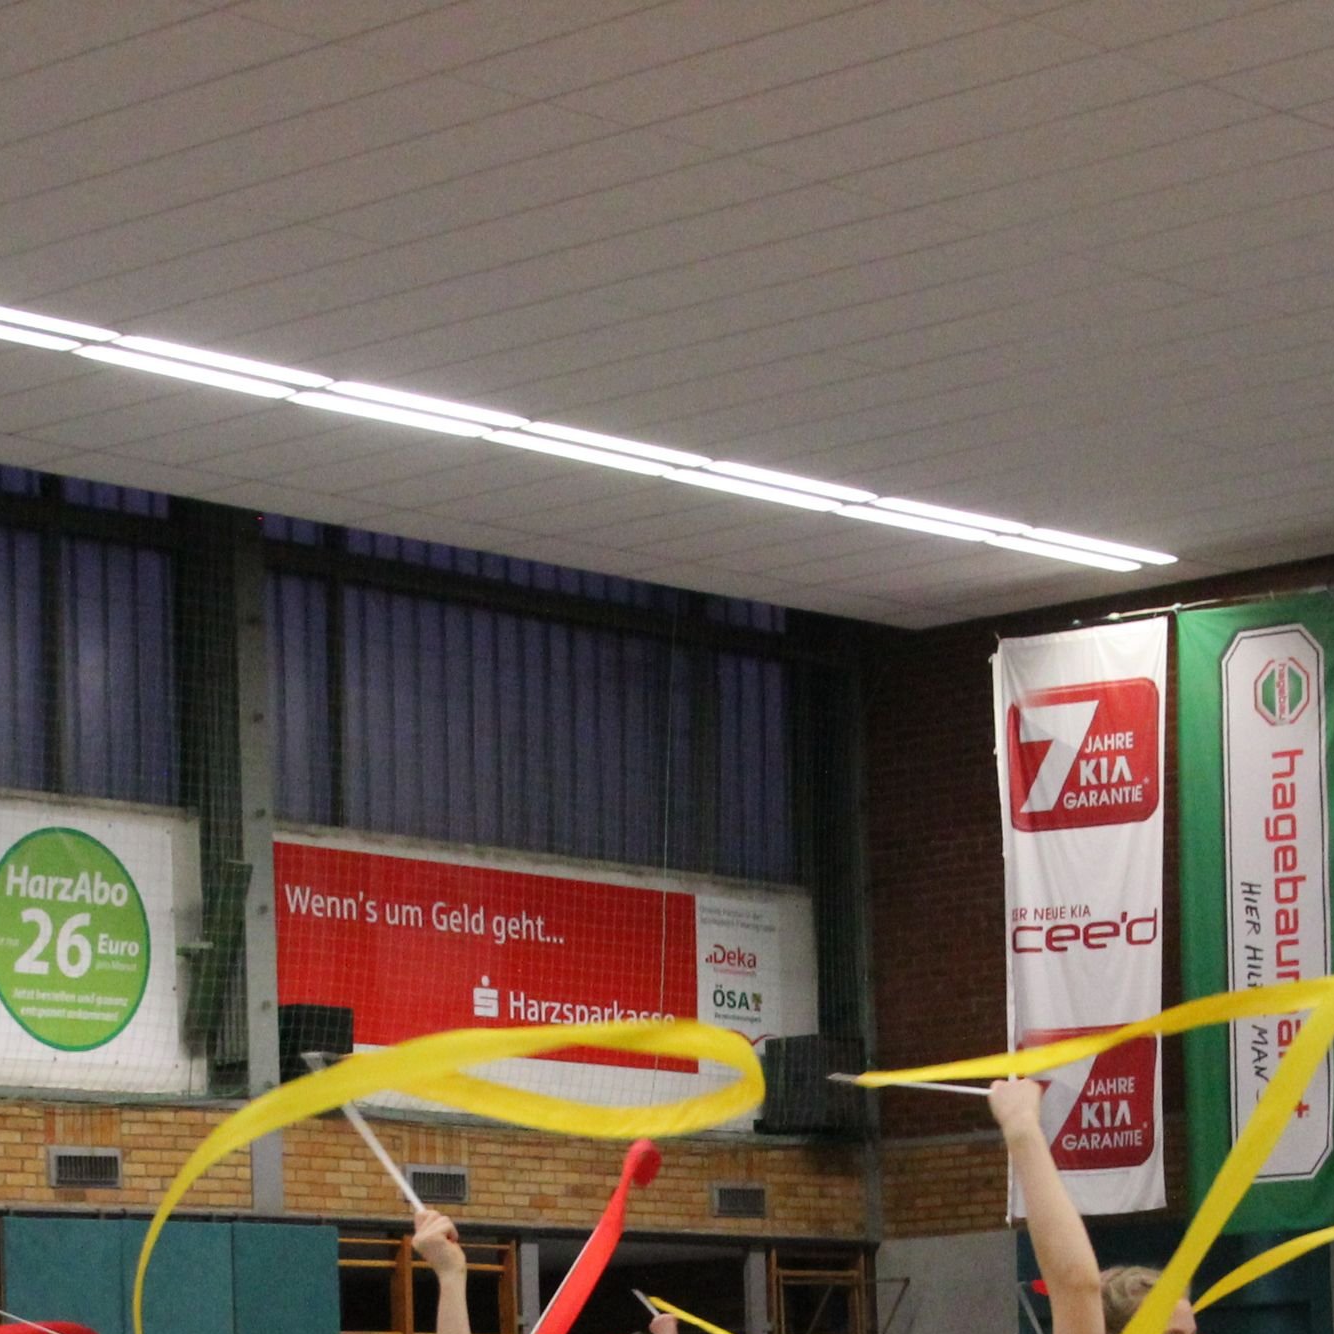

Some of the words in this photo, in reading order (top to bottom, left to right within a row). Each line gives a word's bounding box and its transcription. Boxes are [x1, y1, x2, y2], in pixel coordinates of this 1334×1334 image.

[1019, 700, 1100, 813] 7
[1085, 732, 1134, 754] JAHRE
[1079, 755, 1133, 786] KIA
[1063, 784, 1144, 810] GARANTIE
[5, 863, 128, 908] HarzAbo
[385, 902, 423, 929] um
[431, 901, 485, 934] Geld
[1034, 906, 1067, 921] NEUE
[1070, 904, 1092, 919] KIA
[14, 907, 93, 979] 26
[98, 932, 140, 957] Euro
[1012, 907, 1158, 953] cee'd
[1265, 747, 1309, 1119] hagebauat
[713, 943, 757, 968] Deka
[1240, 881, 1262, 936] HIER
[1251, 1024, 1270, 1082] MAN
[713, 984, 750, 1010] ÖSA
[1087, 1076, 1135, 1097] JAHRE
[1080, 1099, 1132, 1129] KIA
[1062, 1129, 1143, 1151] GARANTIE
